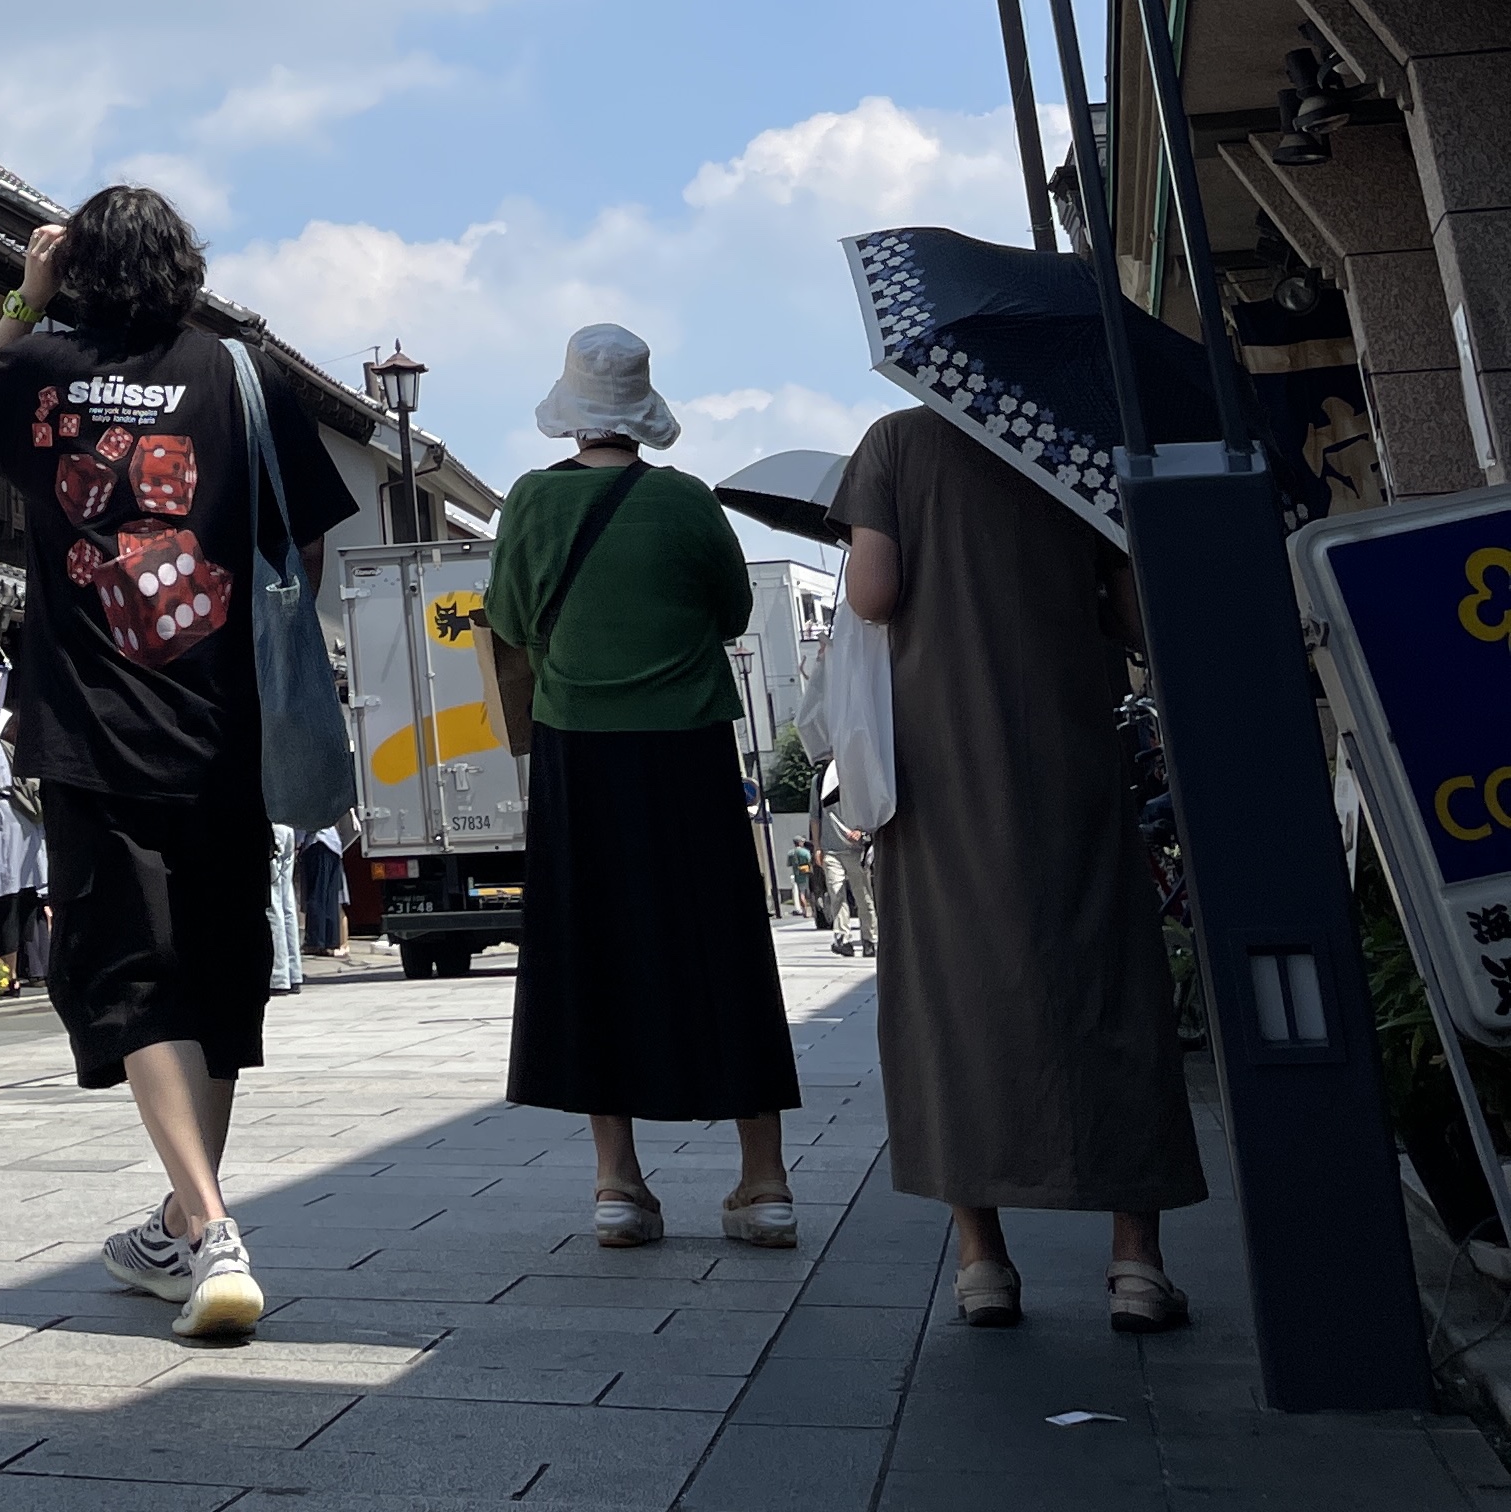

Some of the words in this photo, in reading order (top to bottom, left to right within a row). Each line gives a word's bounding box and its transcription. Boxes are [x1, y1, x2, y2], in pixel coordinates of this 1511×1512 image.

[68, 375, 186, 413] stüssy
[122, 407, 132, 415] los
[132, 409, 158, 417] angeles
[91, 414, 111, 423] tokyo
[113, 415, 137, 423] london
[138, 417, 156, 425] paris
[452, 815, 491, 831] S7834
[395, 901, 434, 915] 31-48
